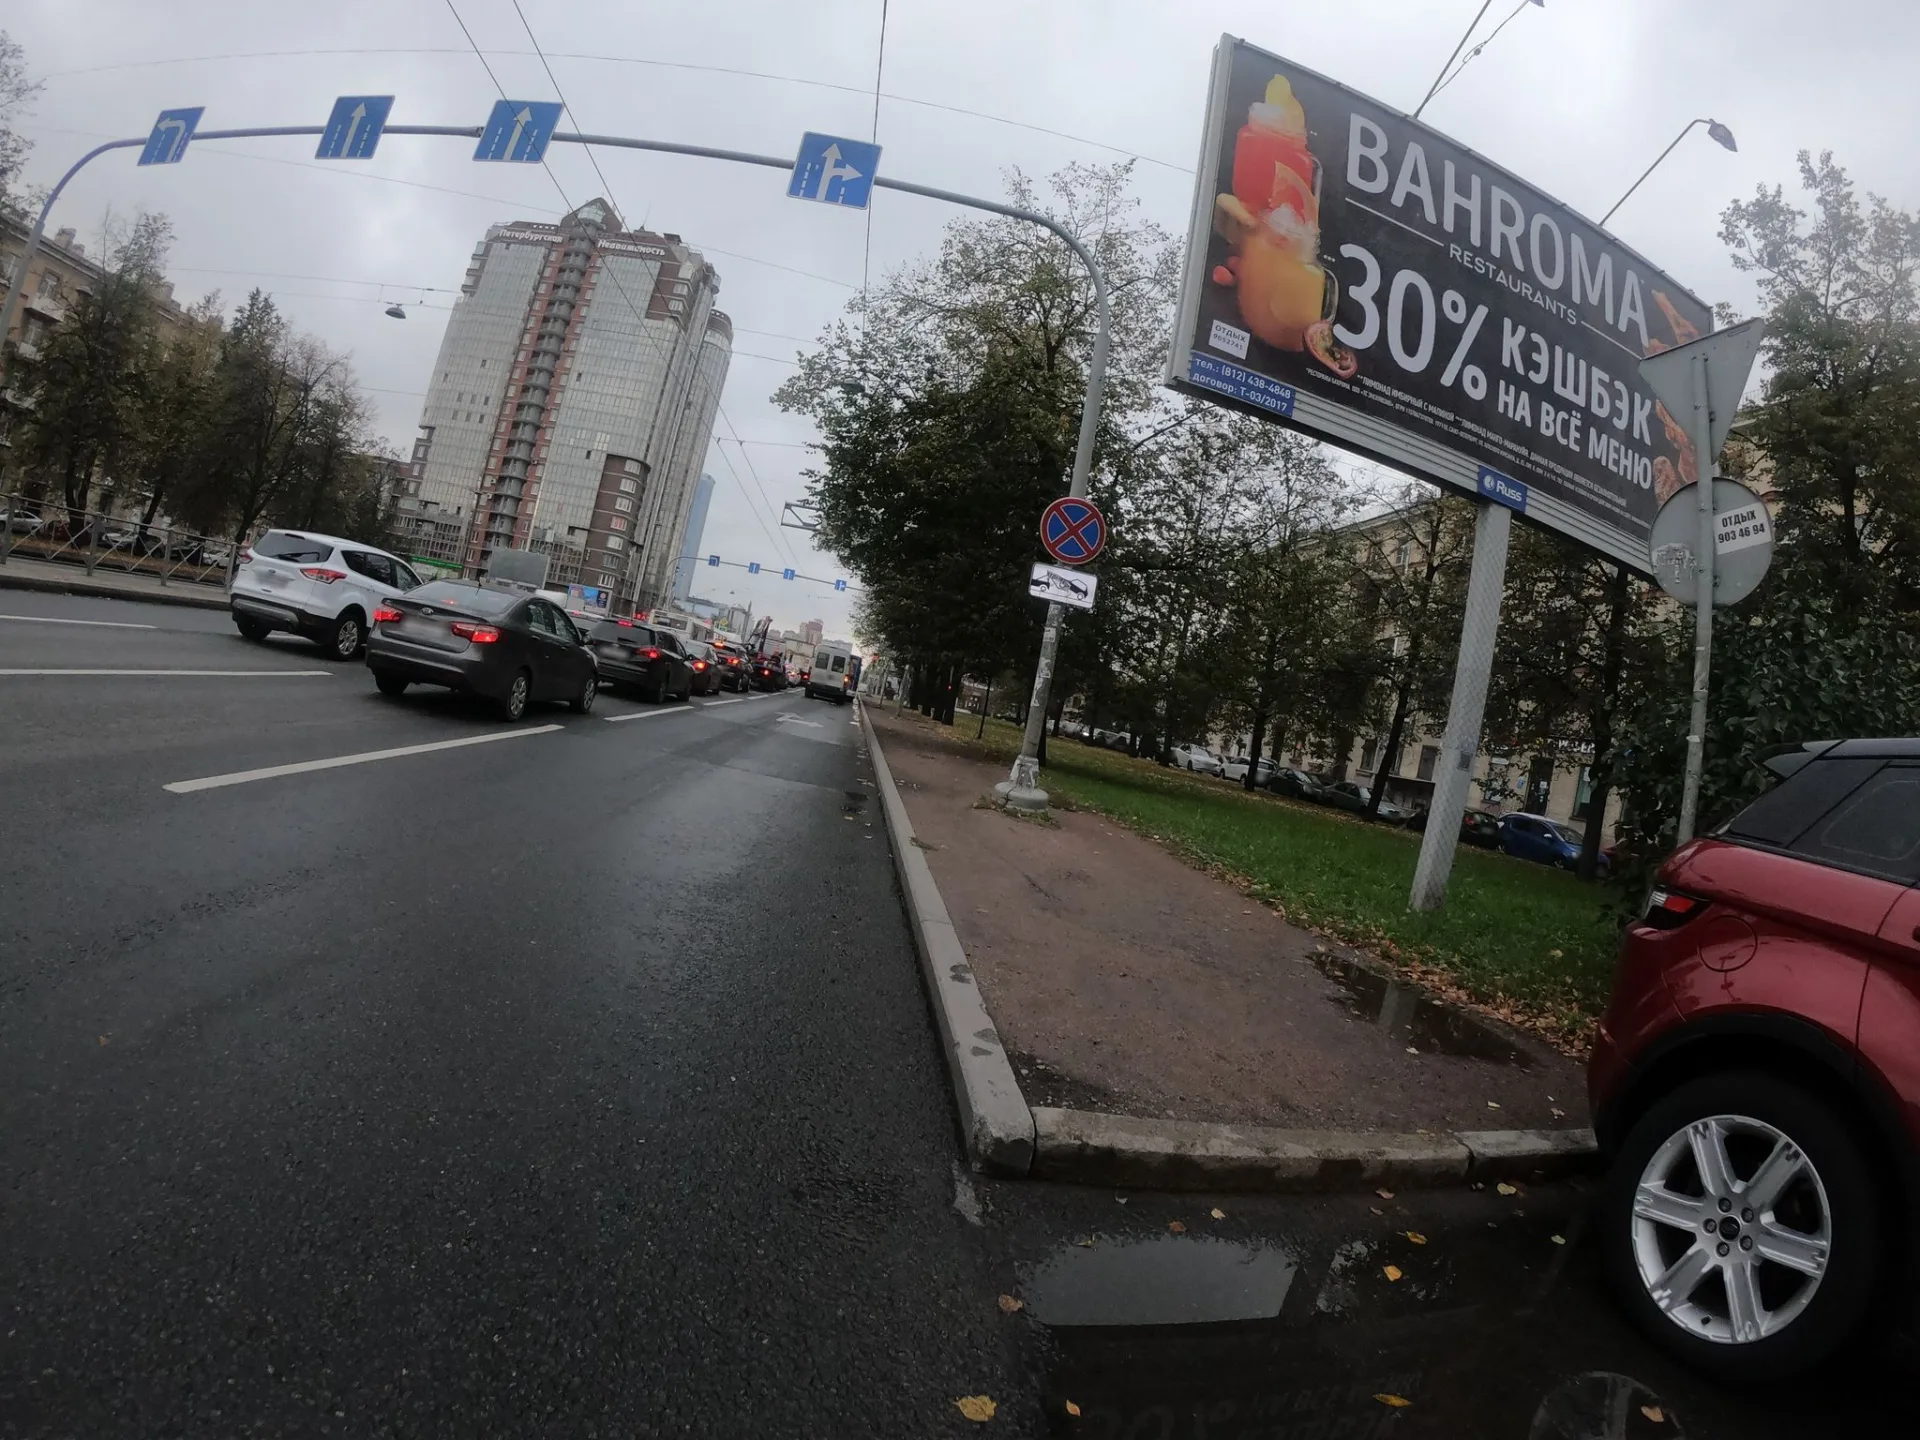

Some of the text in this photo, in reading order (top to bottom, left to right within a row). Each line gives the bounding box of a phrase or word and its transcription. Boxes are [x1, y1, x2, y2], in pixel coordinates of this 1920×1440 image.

[499, 230, 666, 256] Петербургская Недвижимость
[1347, 112, 1650, 348] BAHROMA
[1449, 243, 1577, 325] RESTAURANTS
[1215, 324, 1246, 343] ОТДЫХ
[1333, 243, 1489, 401] 30%
[1192, 372, 1288, 412] договор: Т-03/2017
[1195, 358, 1291, 399] тел.: (812) 438-4848
[1501, 316, 1652, 446] КЭШБЭК
[1498, 379, 1532, 428] НА
[1540, 401, 1582, 452] ВСЁ
[1588, 426, 1652, 490] МЕНЮ
[1496, 480, 1522, 502] Russ
[1718, 522, 1765, 544] 903 46 94
[1721, 509, 1757, 528] ОТДЫХ
